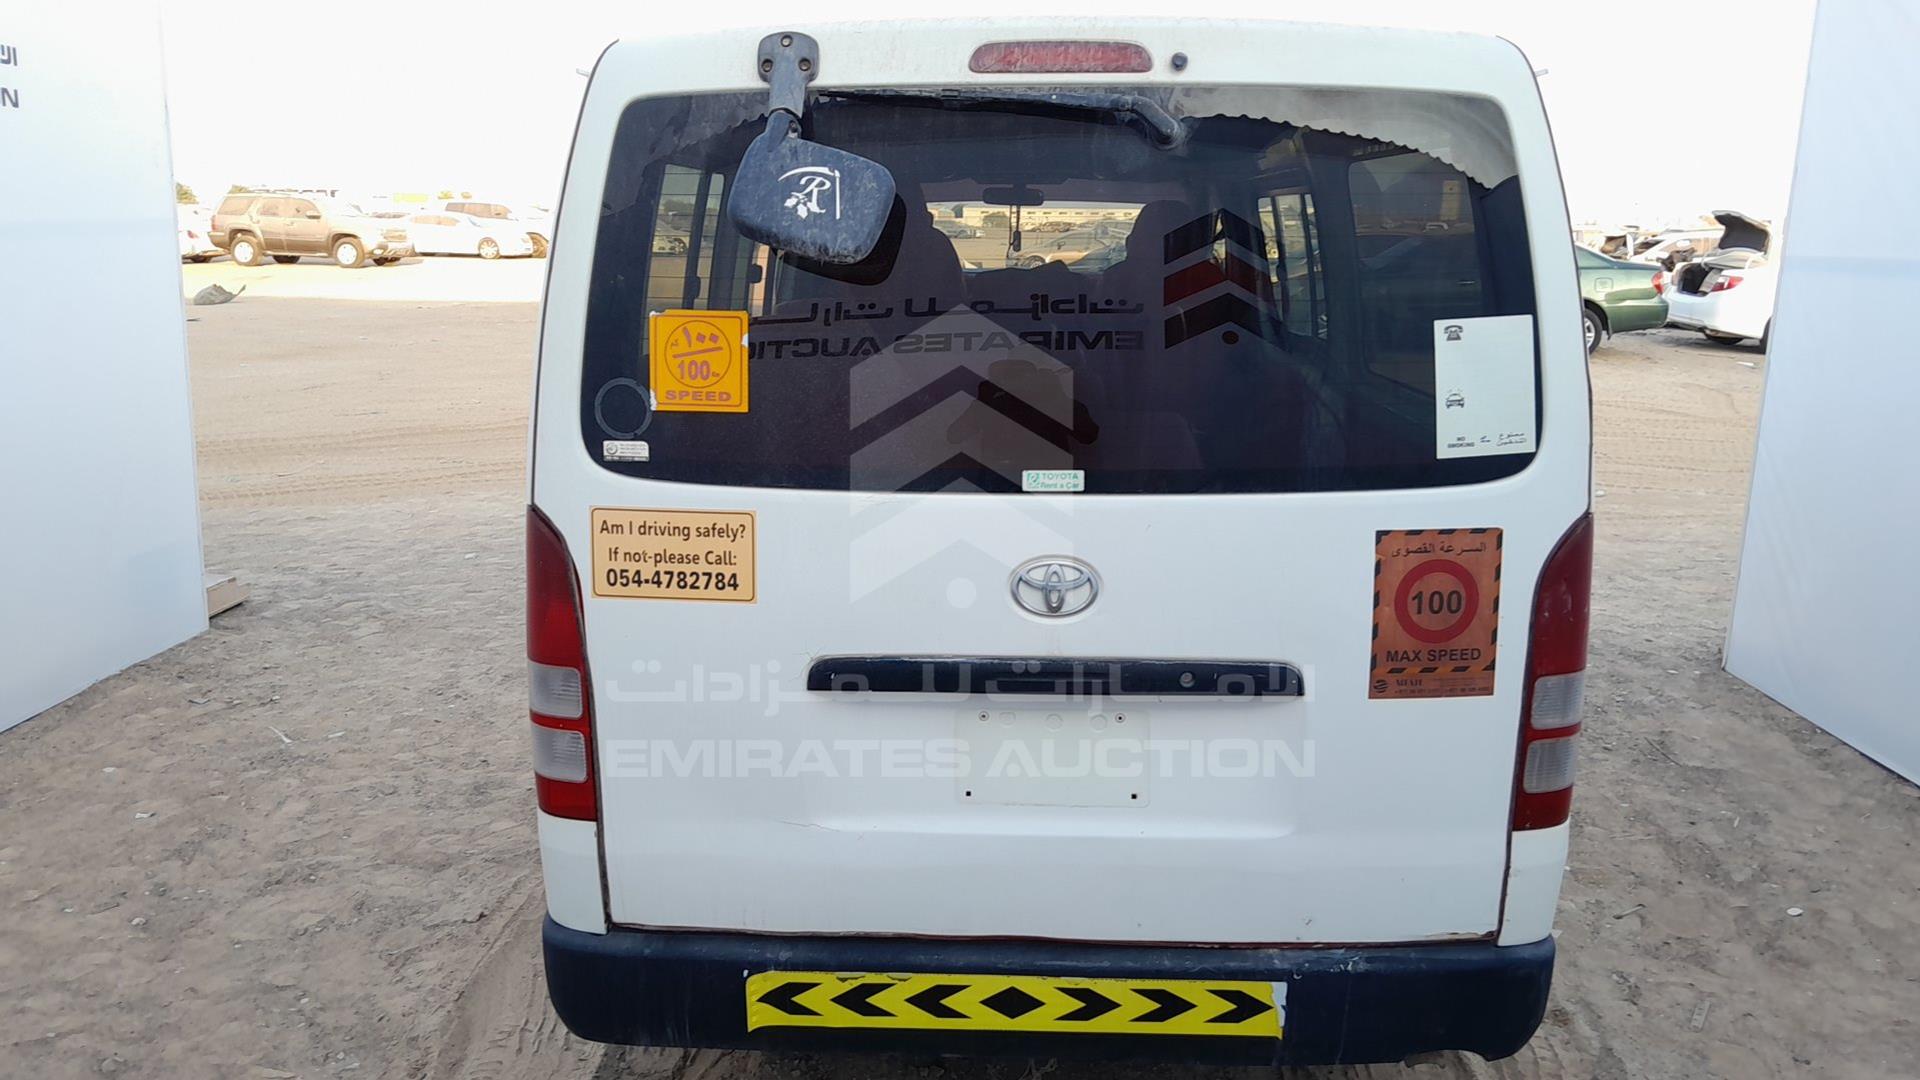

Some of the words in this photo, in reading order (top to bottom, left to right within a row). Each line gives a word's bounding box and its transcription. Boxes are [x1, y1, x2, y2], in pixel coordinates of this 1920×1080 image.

[677, 359, 710, 381] 100
[665, 390, 732, 402] SPEED
[1042, 472, 1079, 480] TOYOTA
[600, 519, 624, 535] Am
[629, 521, 633, 535] I
[638, 521, 691, 541] driving
[695, 522, 746, 543] safely?
[608, 547, 619, 562] If
[705, 551, 737, 566] Call:
[606, 569, 739, 591] 054-4782784
[1412, 591, 1463, 615] 100
[1386, 650, 1422, 663] MAX
[1427, 648, 1481, 662] SPEED
